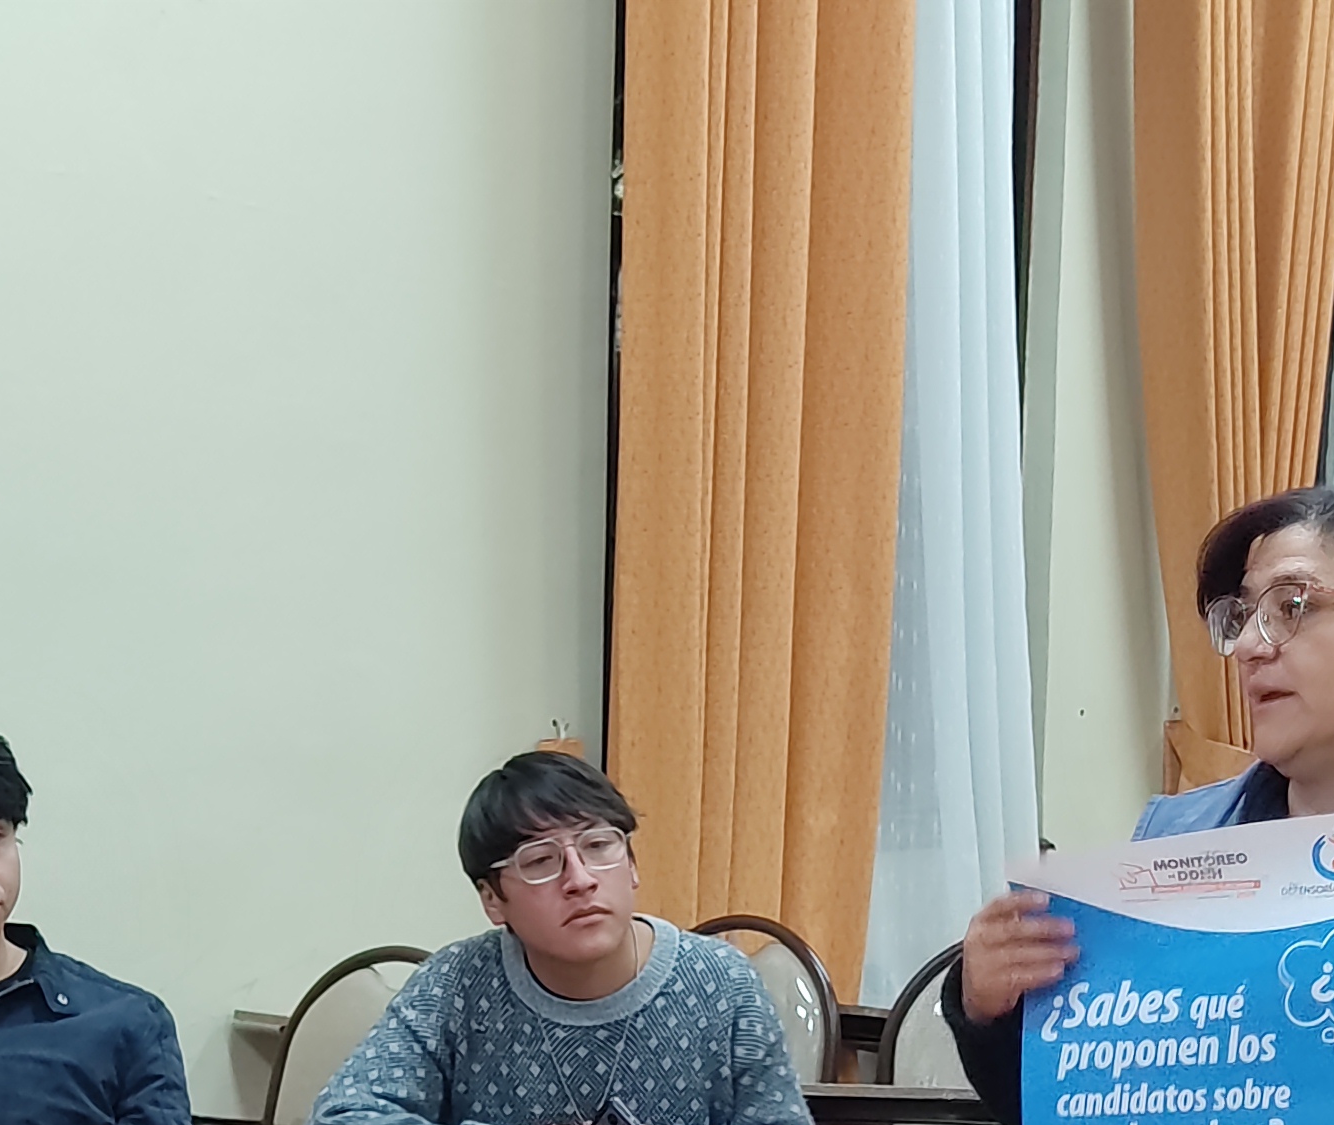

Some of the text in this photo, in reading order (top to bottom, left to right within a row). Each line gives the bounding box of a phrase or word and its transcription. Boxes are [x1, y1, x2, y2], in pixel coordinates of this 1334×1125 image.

[1041, 979, 1246, 1042] ¿Sabes qué
[1056, 1025, 1277, 1081] proponen los
[1056, 1078, 1292, 1118] candidatos sobre
